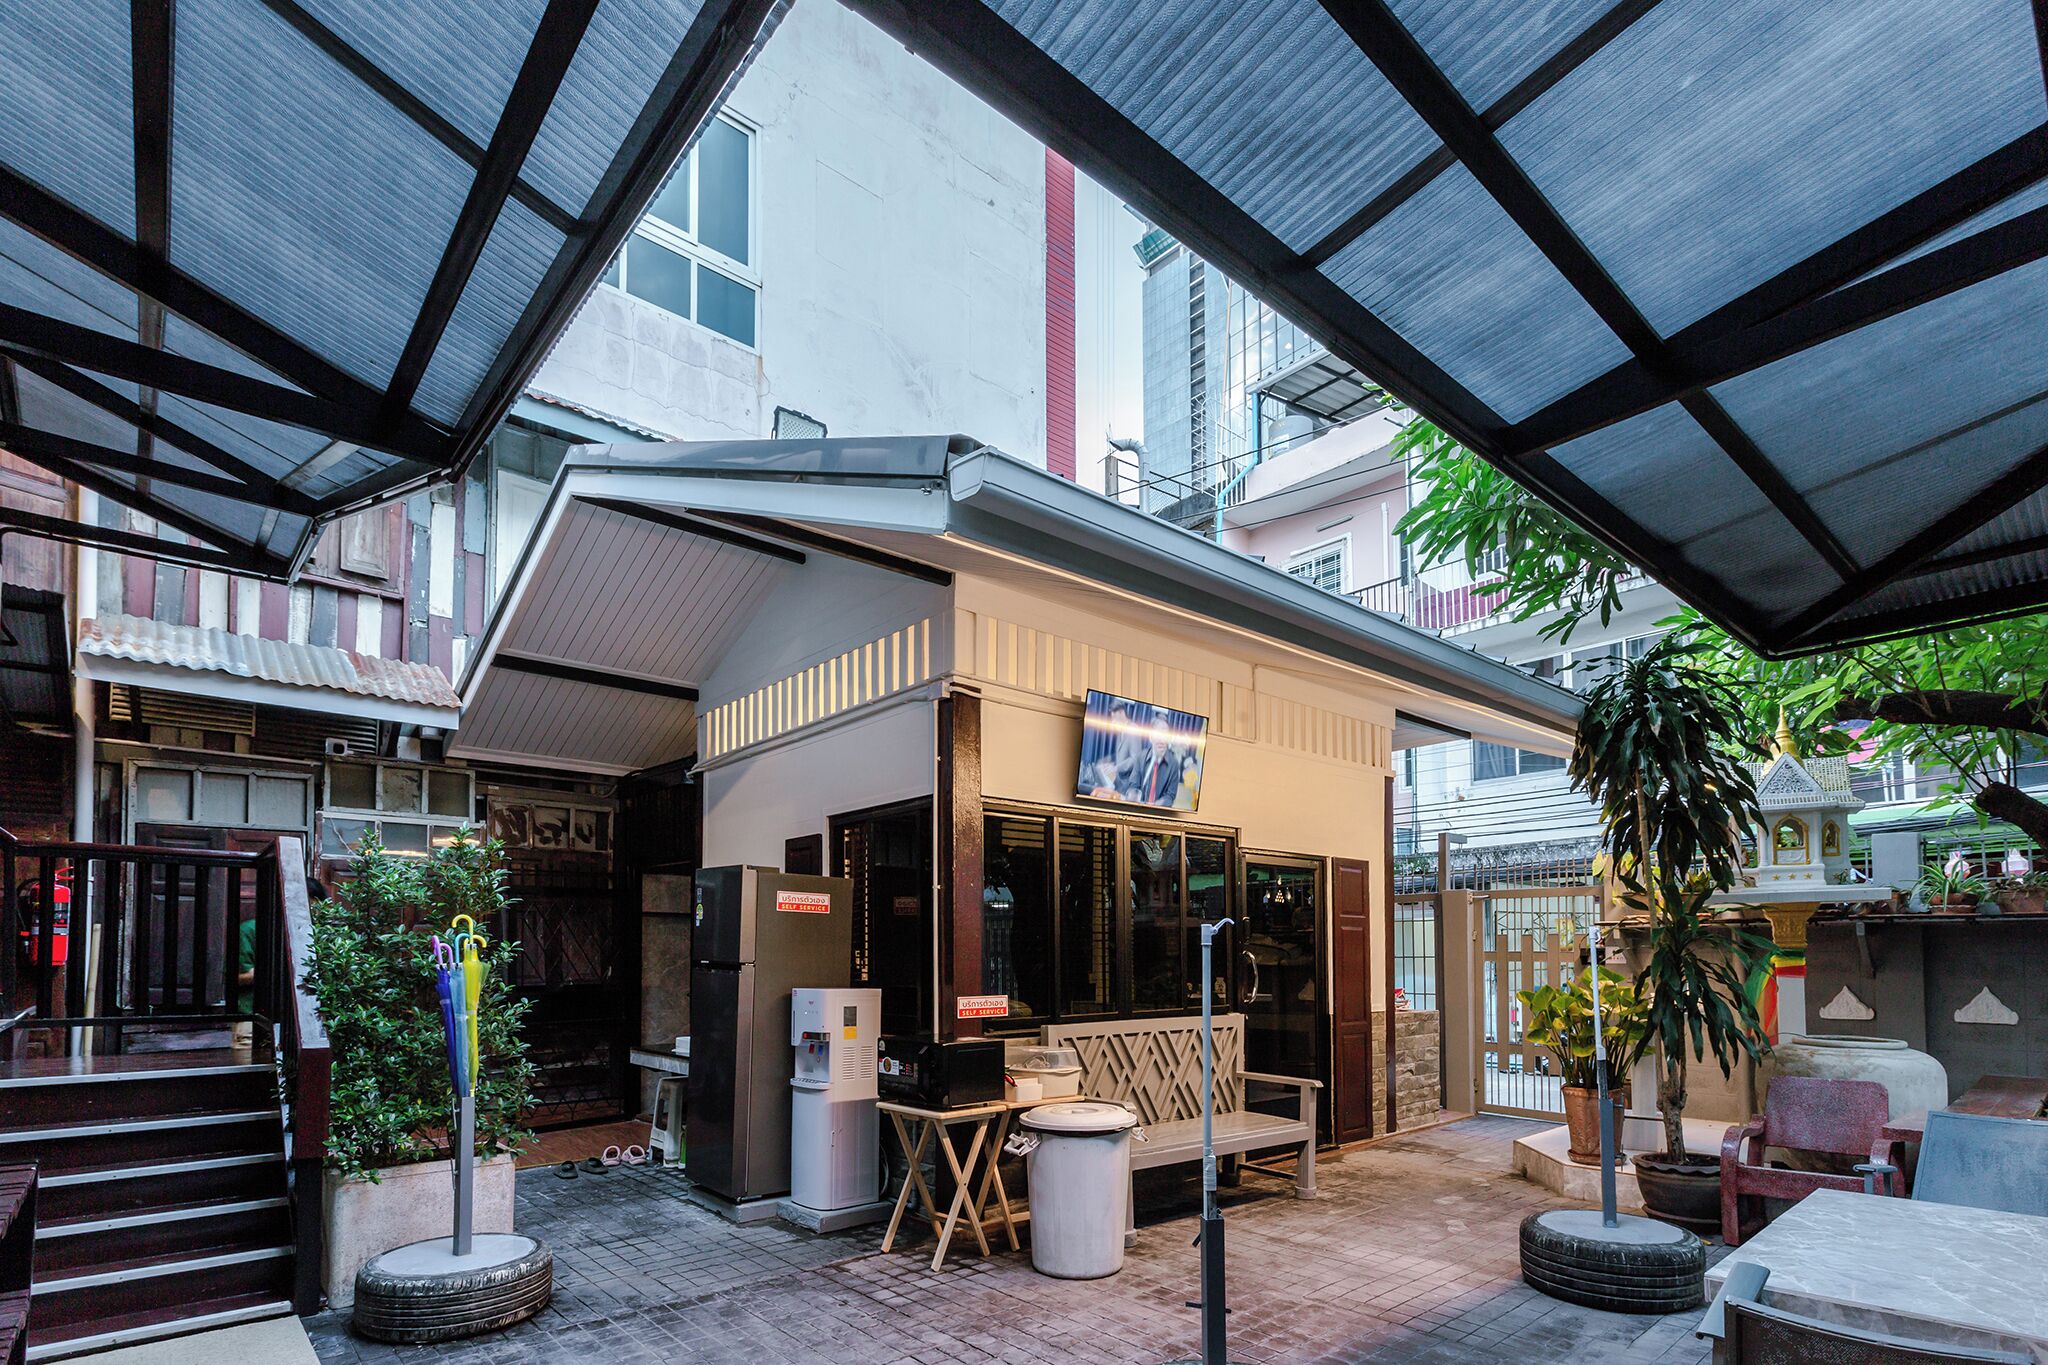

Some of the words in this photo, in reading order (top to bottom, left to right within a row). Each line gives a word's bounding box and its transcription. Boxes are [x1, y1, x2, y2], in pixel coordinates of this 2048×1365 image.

[782, 895, 826, 904] บริการตัวเอง
